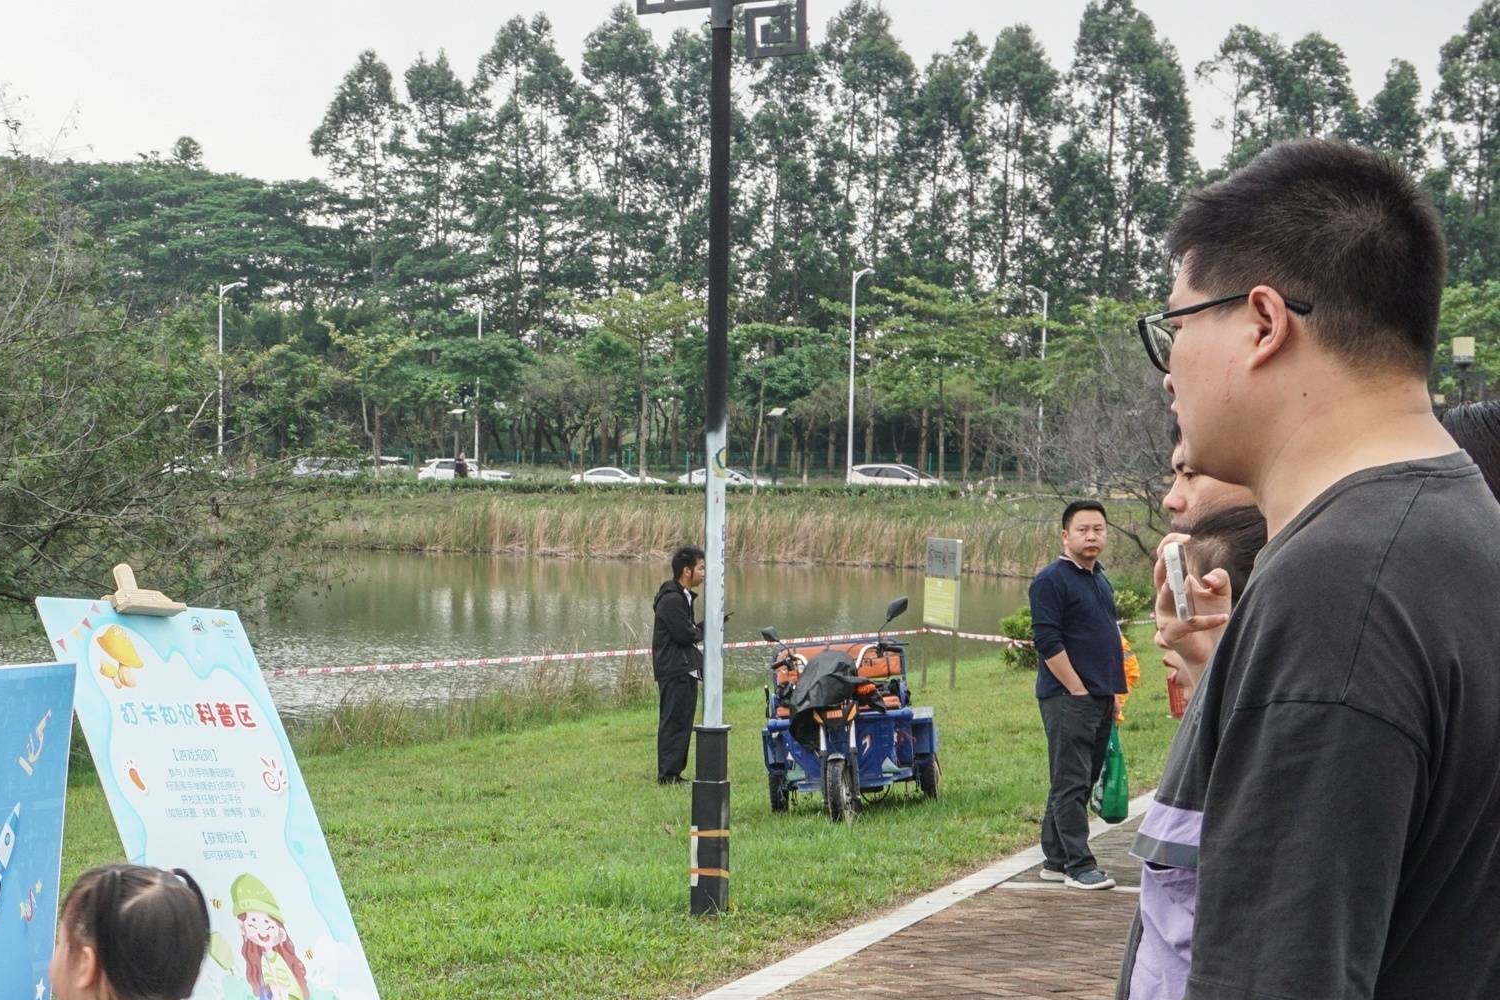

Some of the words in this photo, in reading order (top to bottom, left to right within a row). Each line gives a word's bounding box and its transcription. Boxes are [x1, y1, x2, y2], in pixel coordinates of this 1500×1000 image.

[120, 702, 257, 728] 打卡知识科普区
